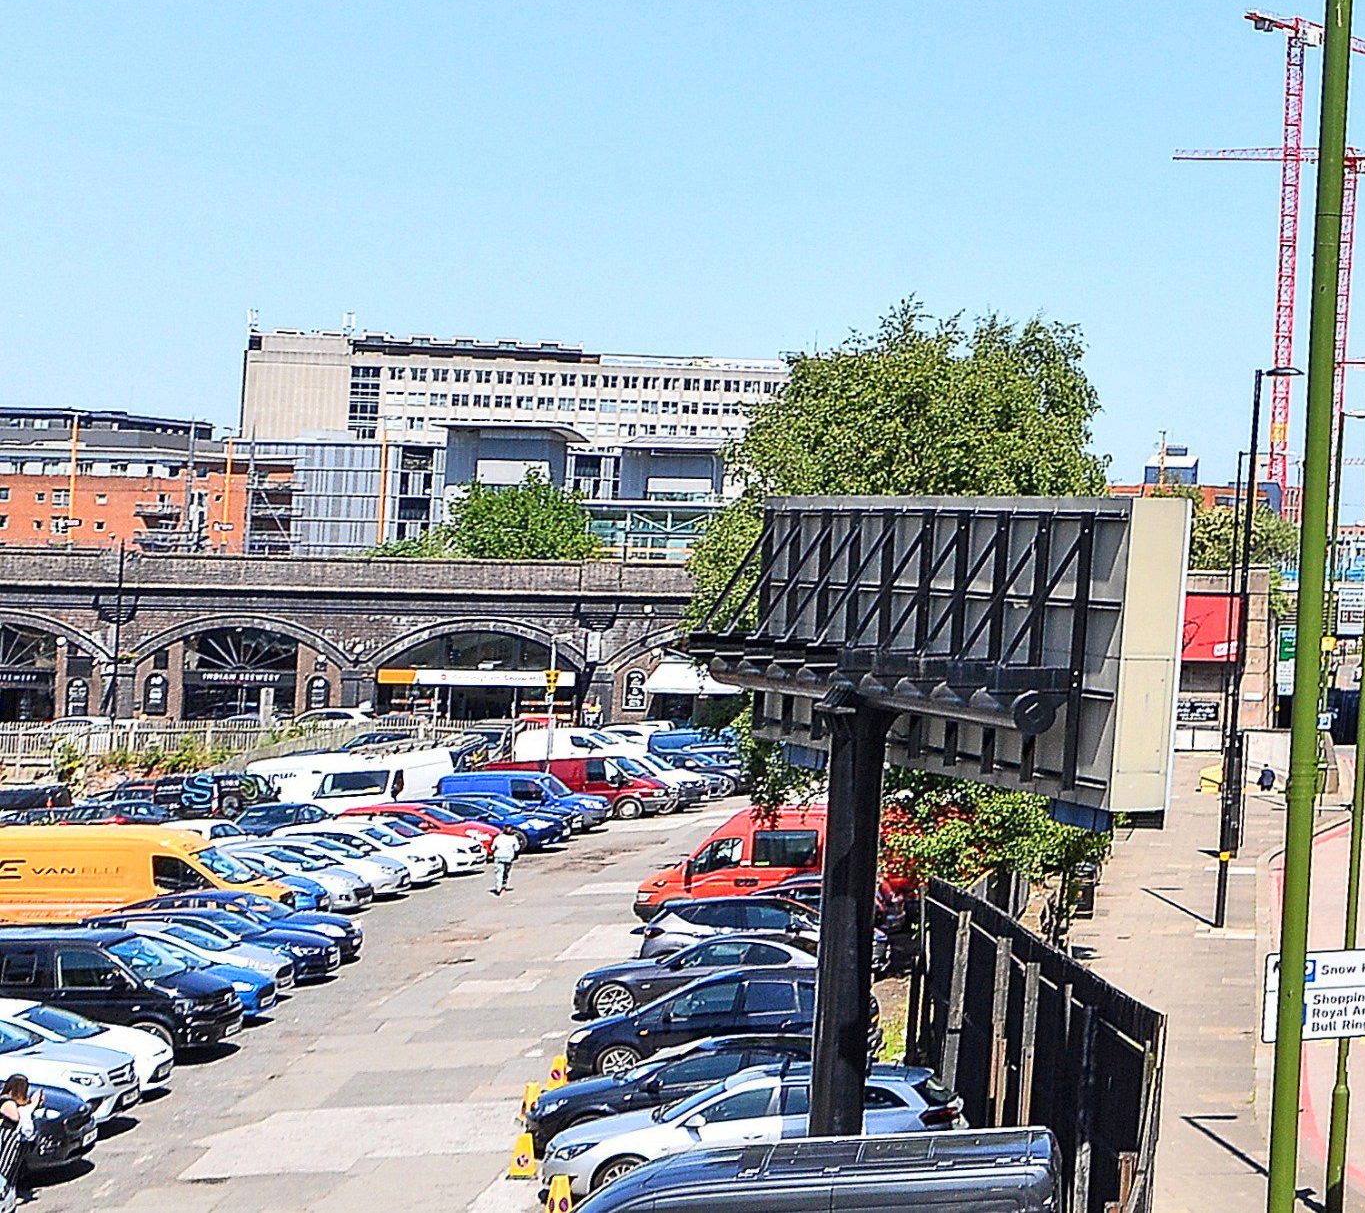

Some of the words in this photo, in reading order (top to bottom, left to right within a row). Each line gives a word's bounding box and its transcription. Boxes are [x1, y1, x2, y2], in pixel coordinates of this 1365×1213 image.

[202, 673, 237, 681] INDIAN
[32, 867, 76, 875] VAN
[1320, 963, 1358, 975] Snow
[1312, 1007, 1348, 1020] Royal
[1311, 1021, 1337, 1033] Bull
